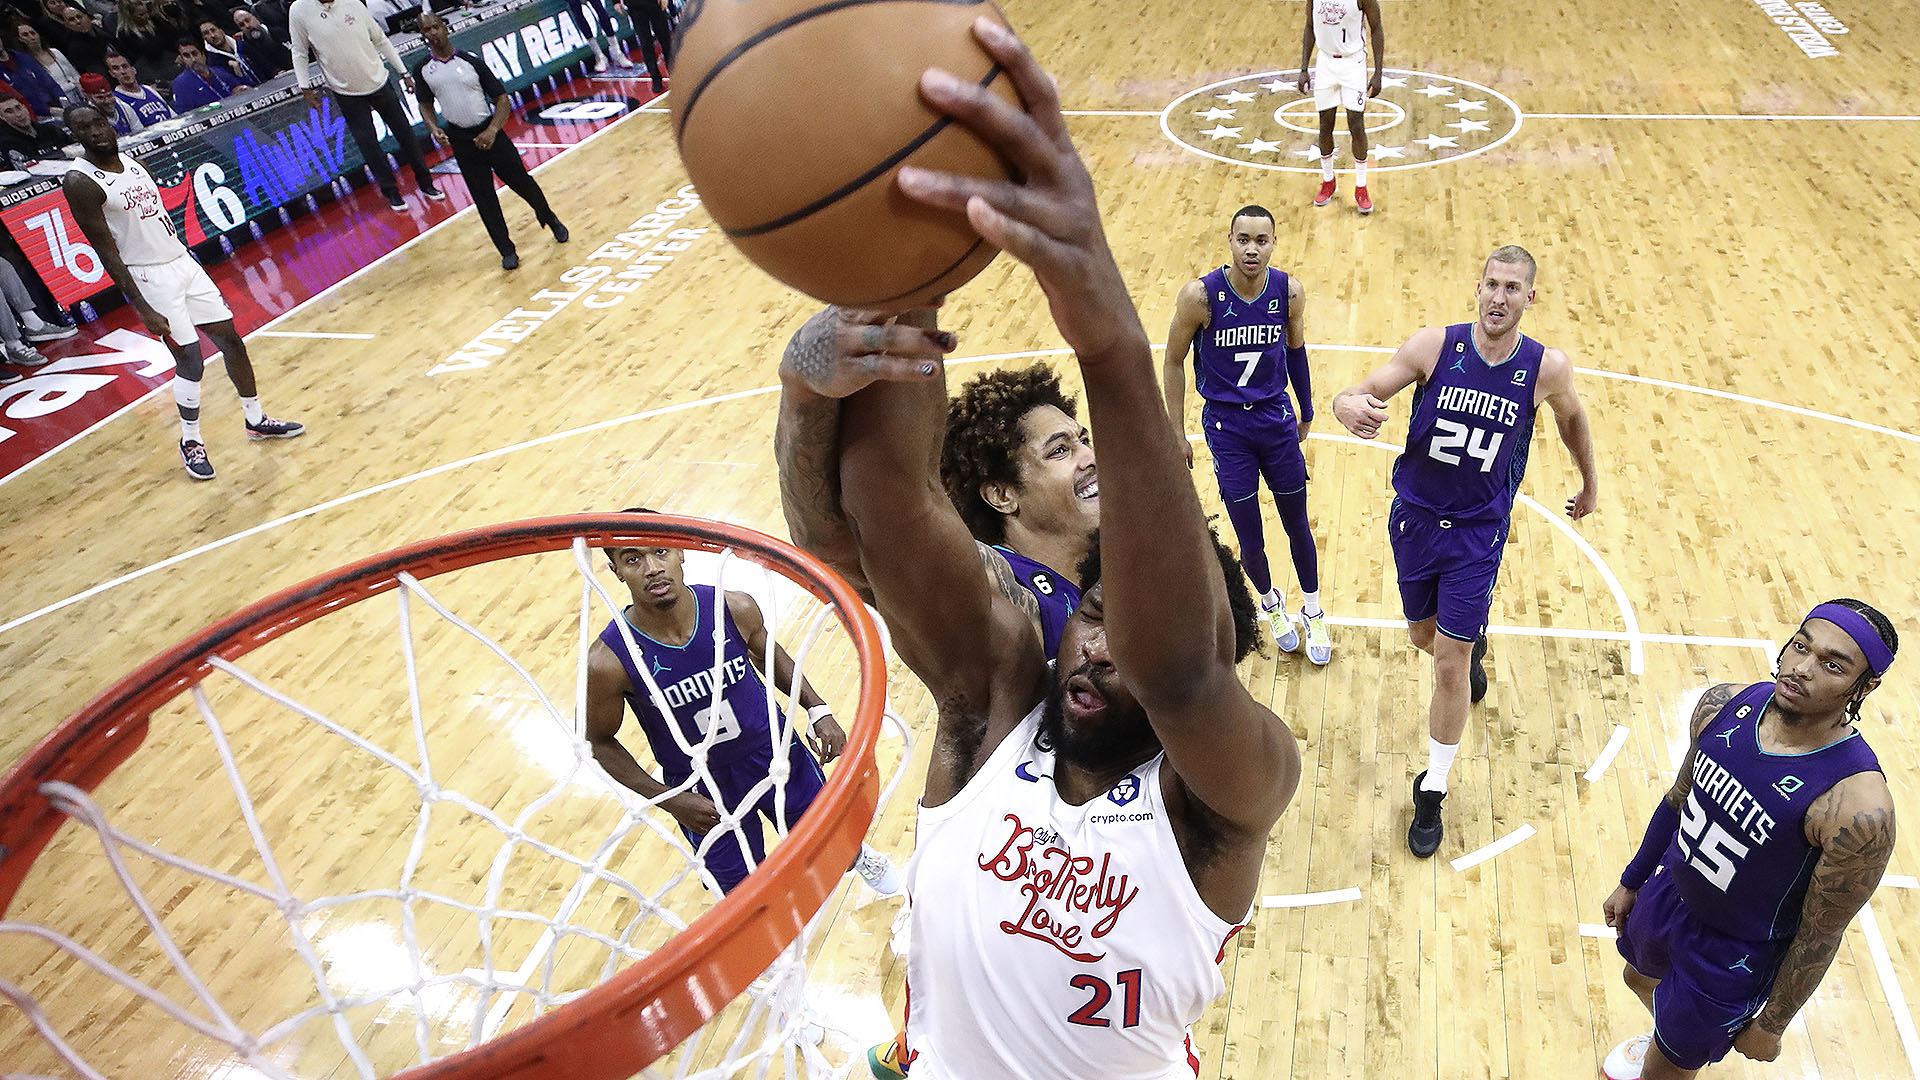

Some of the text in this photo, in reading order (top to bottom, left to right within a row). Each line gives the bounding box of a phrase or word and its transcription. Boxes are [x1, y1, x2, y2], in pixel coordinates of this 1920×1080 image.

[124, 141, 159, 158] STEEL
[161, 122, 208, 145] BIOSTEEL
[209, 105, 252, 127] BIOSTEEL
[0, 176, 58, 207] BIOSTEEL
[24, 207, 105, 284] 76
[158, 214, 176, 237] 18
[582, 226, 710, 310] CENTER
[1218, 291, 1226, 301] 6
[425, 264, 614, 377] WELLS
[1214, 324, 1282, 347] HORNETS
[1234, 352, 1263, 387] 7
[1436, 385, 1520, 427] HORNETS
[1428, 418, 1504, 473] 24
[1033, 574, 1053, 595] 6
[1735, 705, 1751, 720] 6
[1090, 812, 1154, 824] crypto.com
[1692, 749, 1776, 846] HORNETS
[1676, 786, 1750, 894] 25
[1000, 884, 1106, 963] Love
[1067, 968, 1142, 1029] 21
